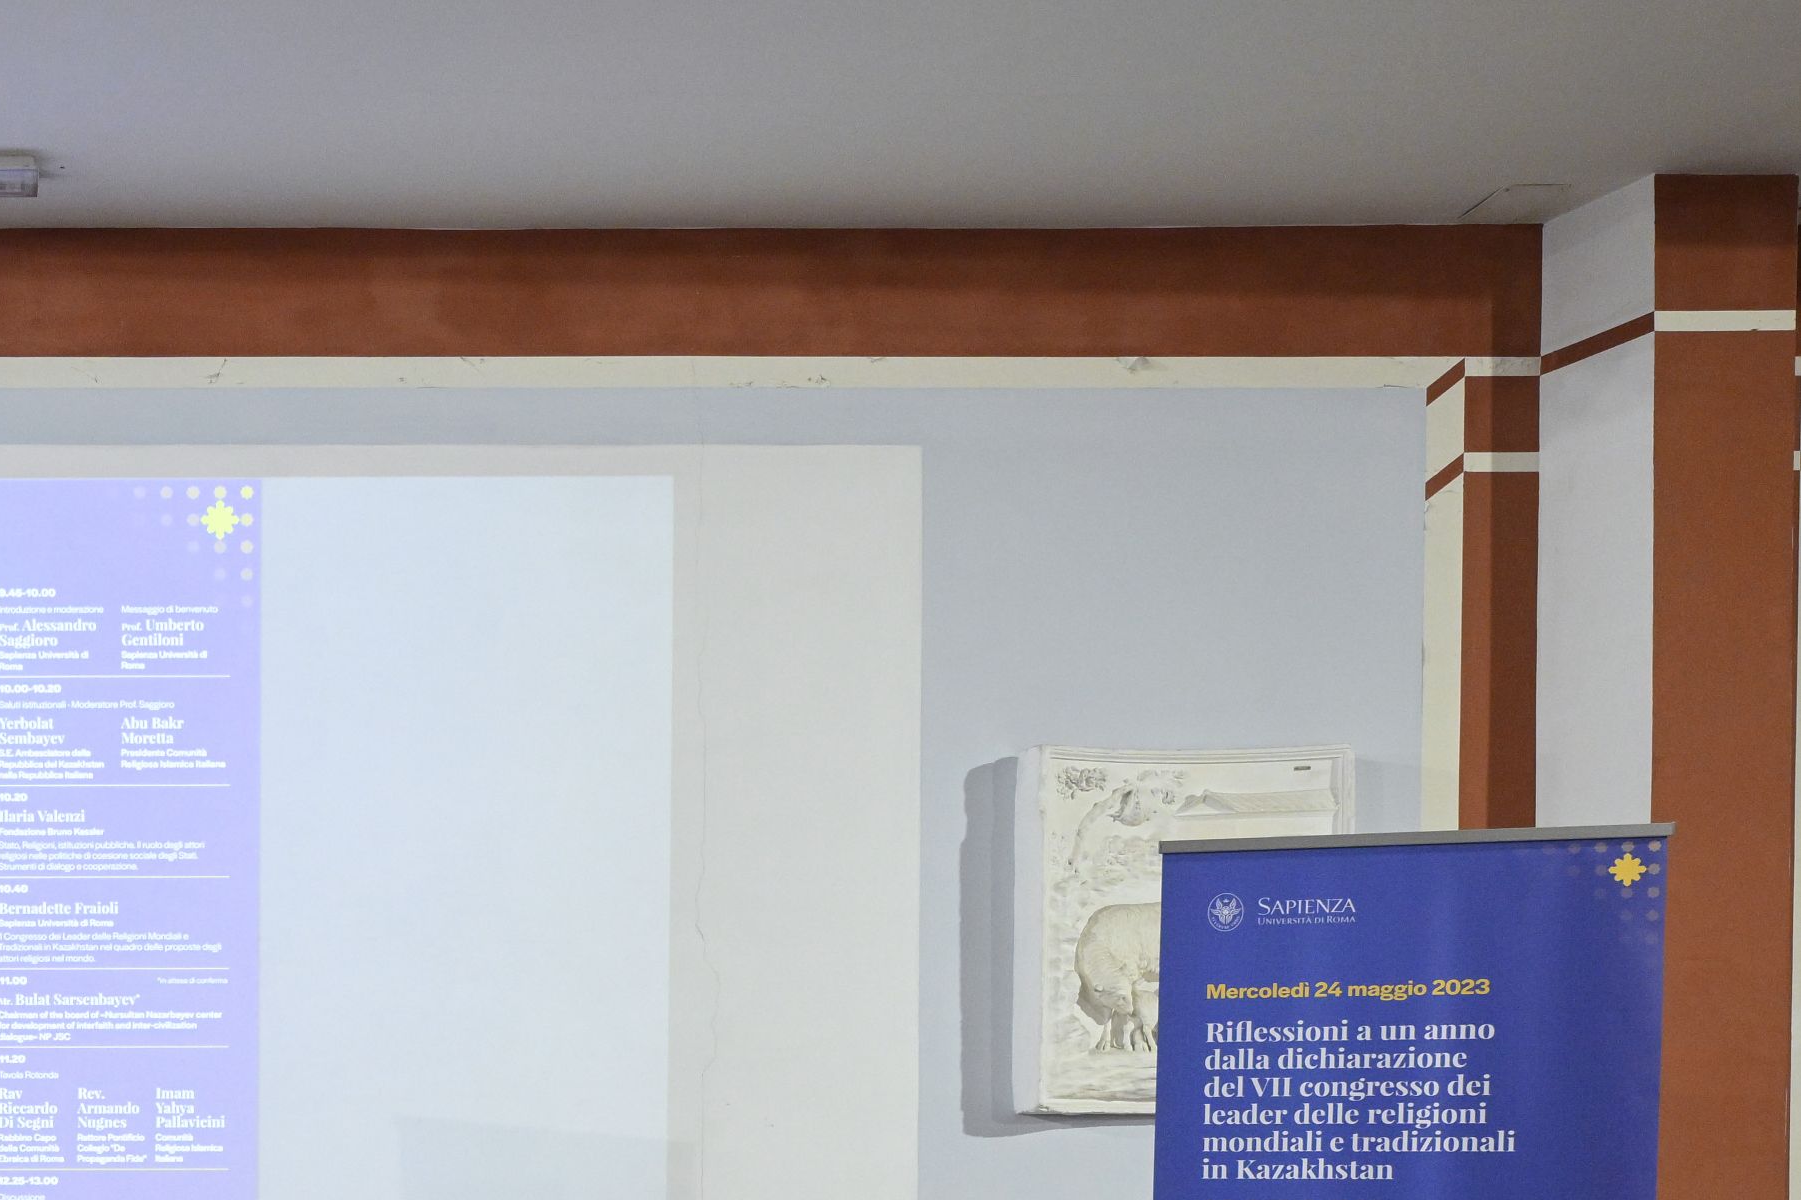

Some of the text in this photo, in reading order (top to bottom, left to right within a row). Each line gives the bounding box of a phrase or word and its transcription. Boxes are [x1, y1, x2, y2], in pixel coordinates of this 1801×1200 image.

[0, 618, 97, 632] Prof. Alessandro
[122, 618, 204, 631] Prof. Umberto
[0, 634, 58, 649] Saggioro
[122, 633, 183, 646] Gentiloni
[0, 810, 85, 823] Ilaria Valenzi
[0, 902, 118, 915] Bernadette Fraioli
[1207, 979, 1490, 1001] Mercoledì 24 maggio 2023
[1207, 1020, 1495, 1043] Riflessioni a un anno
[1205, 1047, 1467, 1070] dalla dichiarazione
[1204, 1074, 1490, 1101] del VII congresso dei
[0, 1102, 58, 1114] Riccardo
[1204, 1102, 1486, 1129] leader delle religioni
[0, 1116, 54, 1131] Di Segni
[1203, 1130, 1515, 1152] mondiali e tradizionali
[1203, 1158, 1393, 1180] in Kazakhstan
